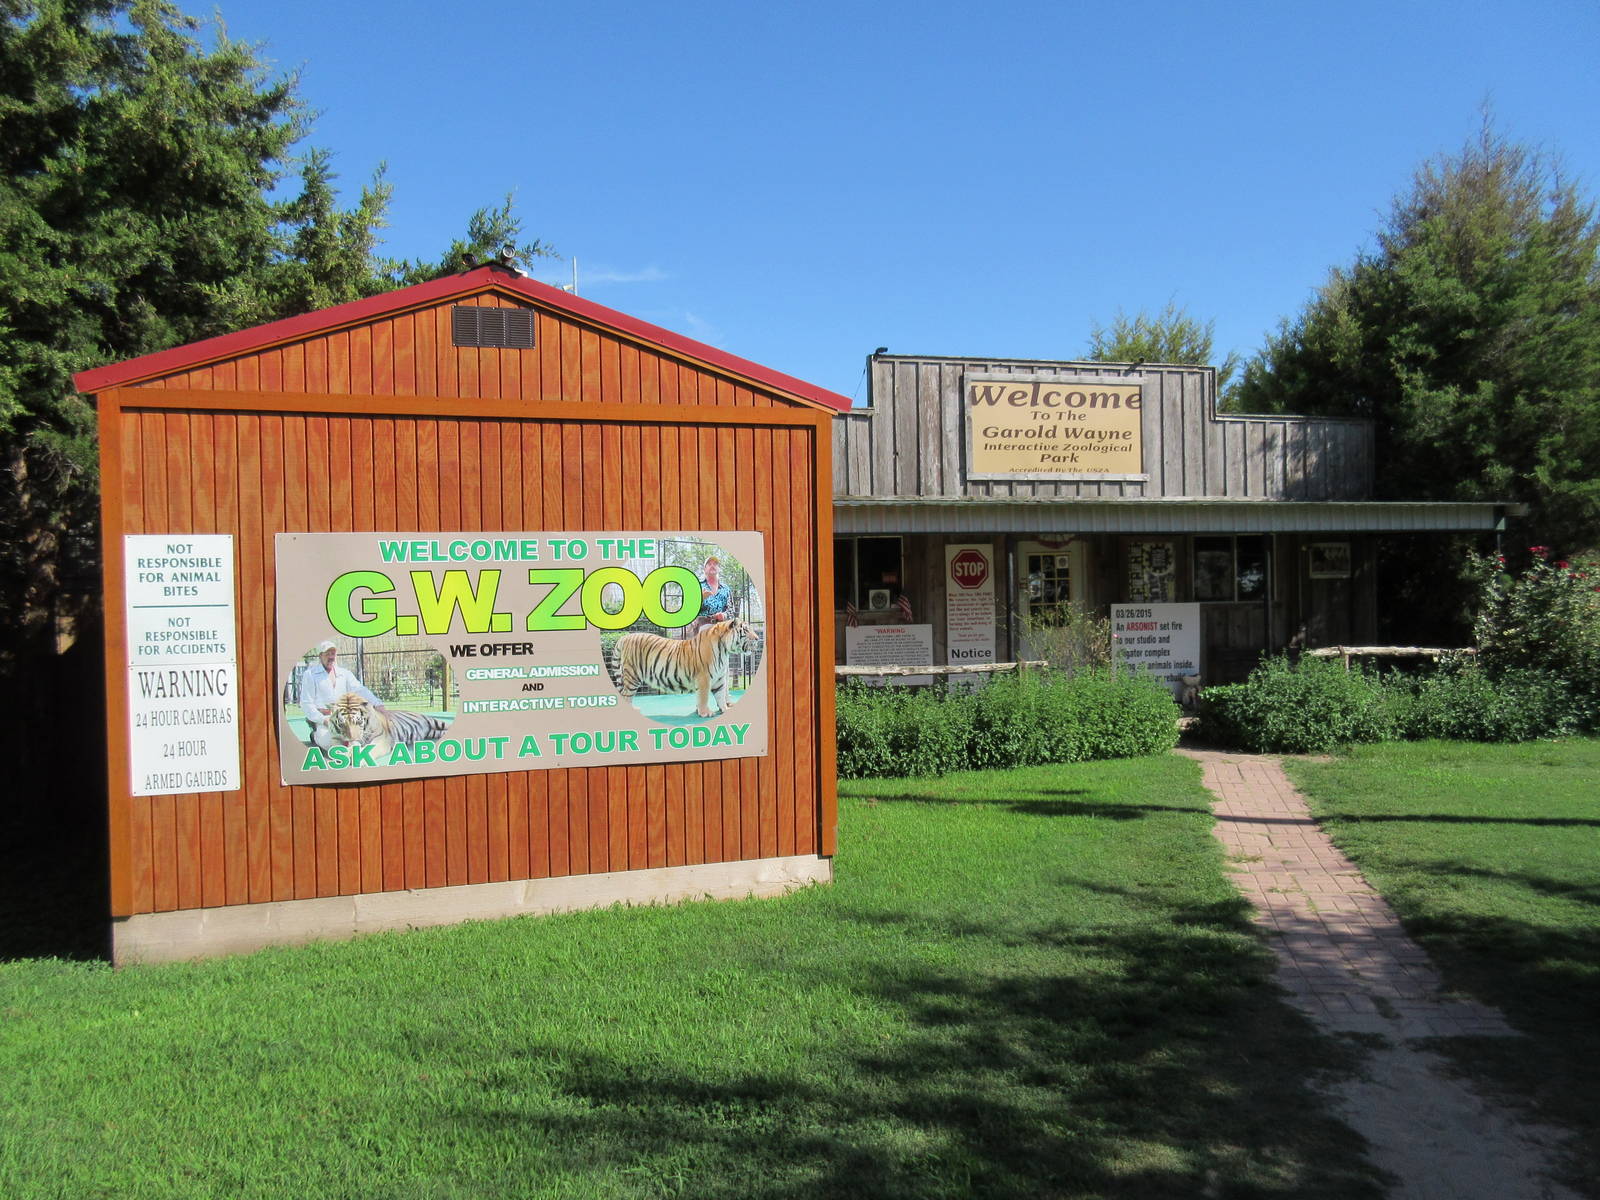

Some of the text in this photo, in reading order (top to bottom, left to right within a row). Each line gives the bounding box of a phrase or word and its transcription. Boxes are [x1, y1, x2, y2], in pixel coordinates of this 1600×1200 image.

[970, 382, 1142, 410] Welcome
[1030, 411, 1087, 421] To The
[982, 425, 1133, 443] Garold Wayne
[984, 442, 1133, 454] Interactive Zoological
[1040, 453, 1080, 464] Park
[166, 543, 193, 554] NOT
[379, 538, 656, 563] WELCOME TO THE
[137, 556, 222, 569] RESPONSIBLE
[955, 561, 985, 577] STOP
[139, 571, 221, 583] FOR ANIMAL
[163, 585, 198, 597] BITES
[325, 566, 704, 638] G.W. ZOO
[168, 616, 191, 628] NOT
[1116, 621, 1183, 632] An ARSONIST set fire
[145, 628, 218, 642] RESPONSIBLE
[1124, 637, 1135, 645] our
[1136, 635, 1157, 645] studio
[1158, 635, 1170, 644] and
[138, 642, 227, 656] FOR ACCIDENTS
[449, 642, 534, 658] WE OFFER
[951, 648, 992, 659] Notice
[1144, 648, 1171, 658] complex
[465, 664, 599, 681] GENERAL ADMISSION
[1147, 661, 1172, 670] animals
[138, 668, 228, 699] WARNING
[521, 682, 544, 692] AND
[463, 694, 618, 714] INTERACTIVE TOURS
[136, 708, 232, 728] 24 HOUR CAMERAS
[163, 740, 207, 759] 24 HOUR
[302, 723, 752, 773] ASK ABOUT A TOUR TODAY
[145, 769, 227, 791] ARMED GAURDS
